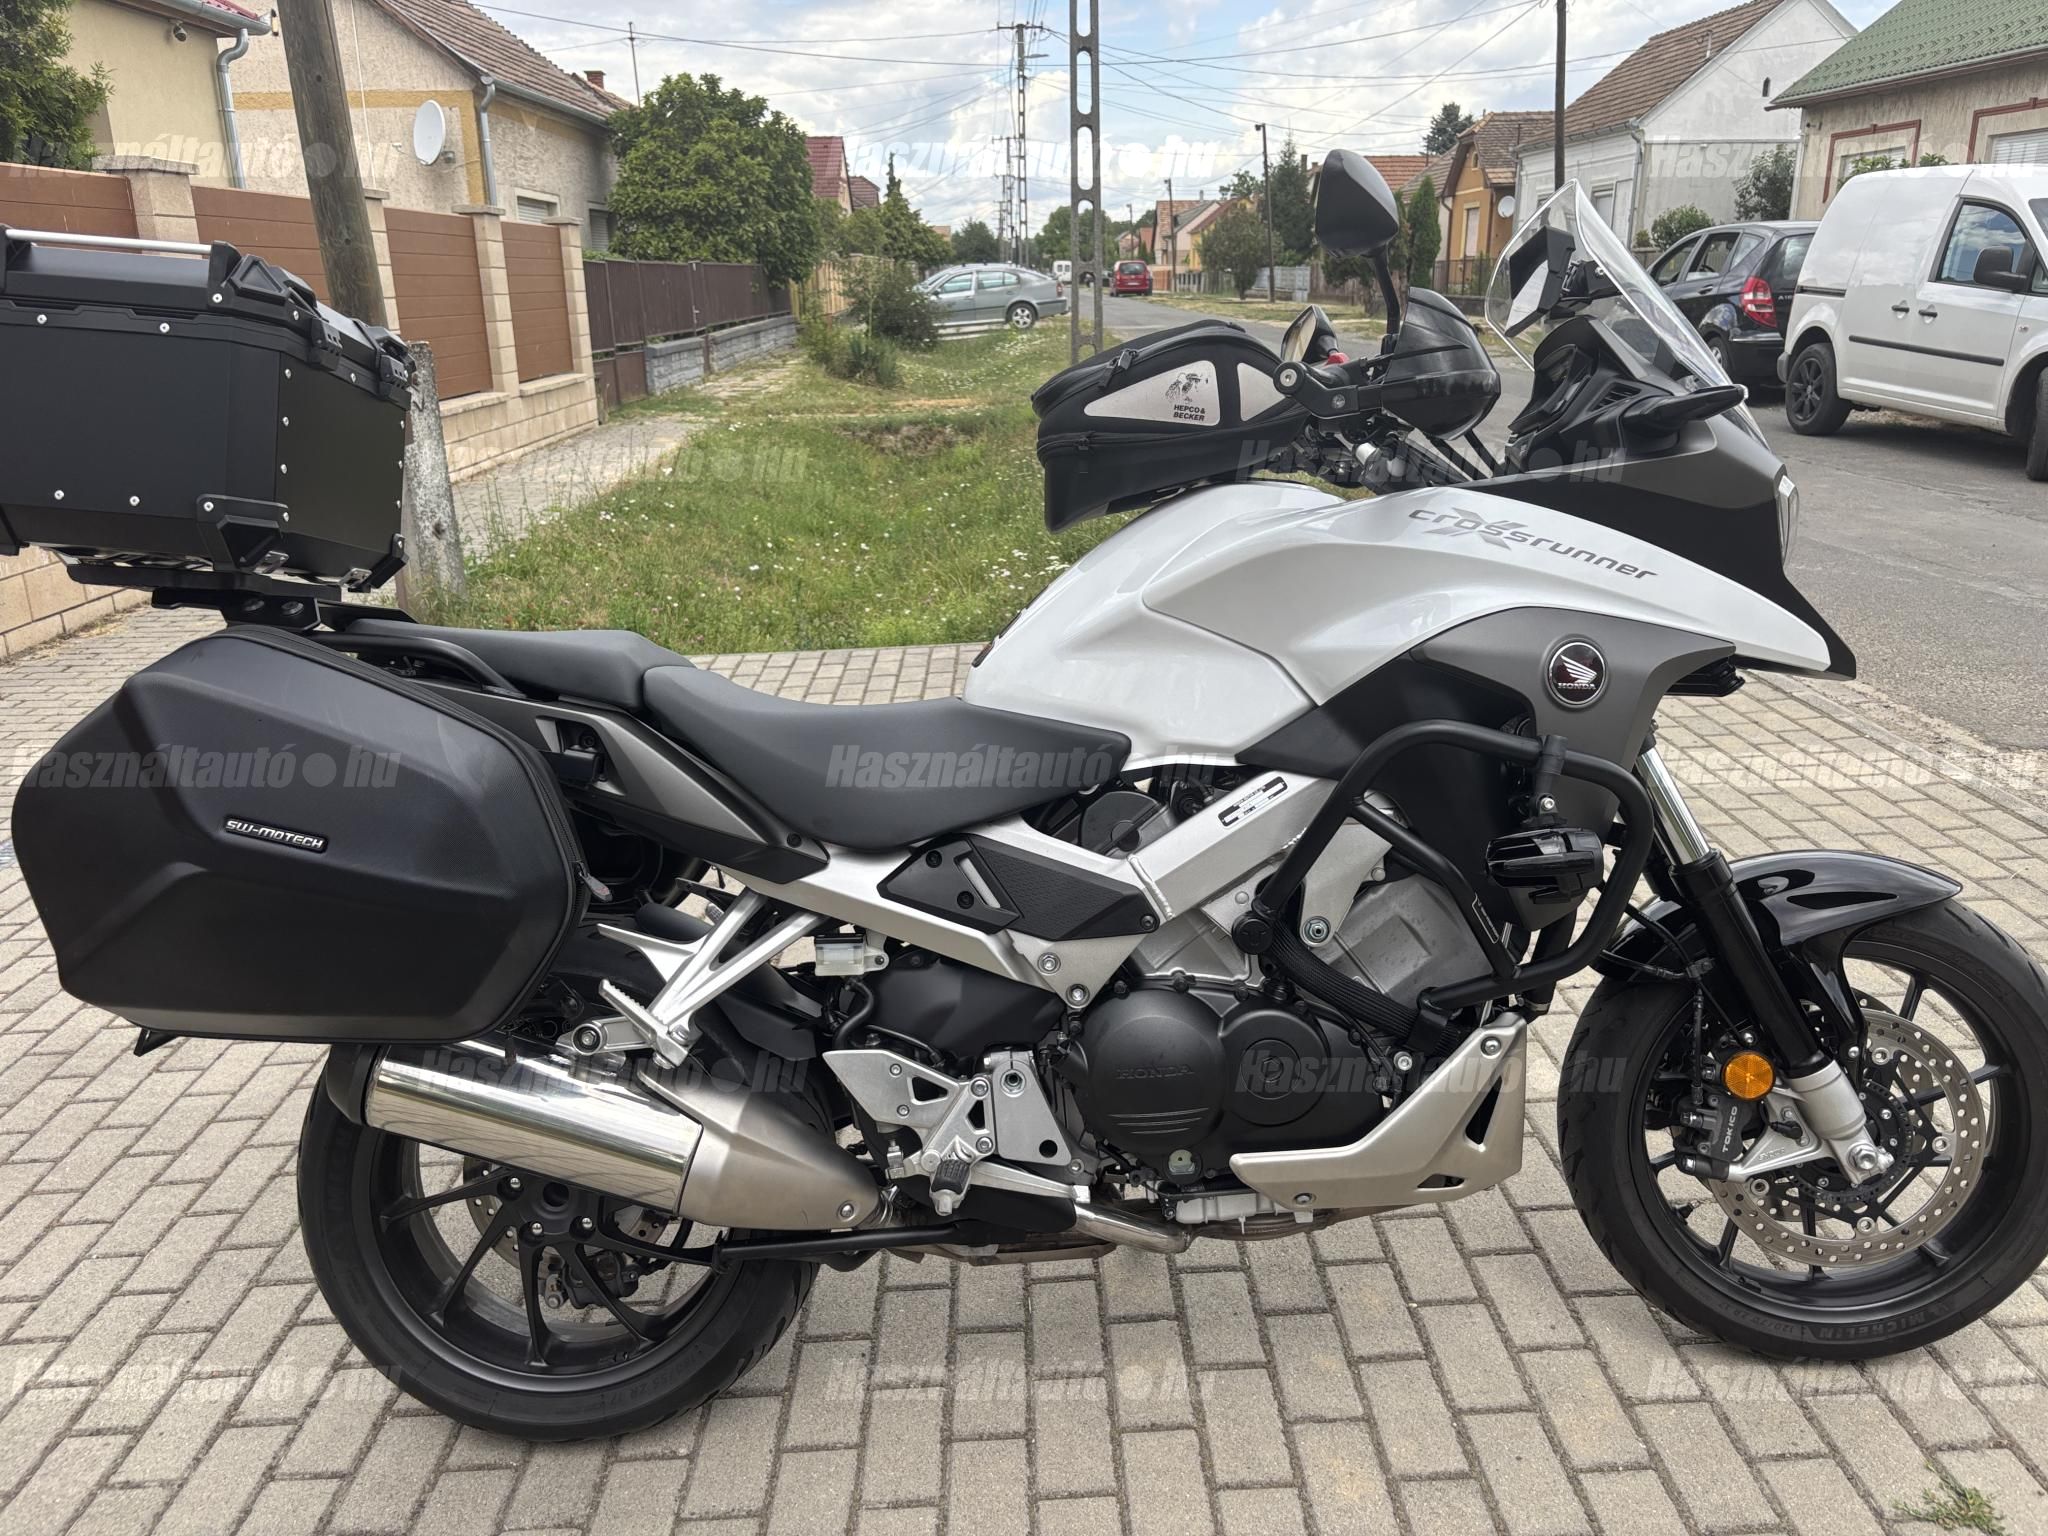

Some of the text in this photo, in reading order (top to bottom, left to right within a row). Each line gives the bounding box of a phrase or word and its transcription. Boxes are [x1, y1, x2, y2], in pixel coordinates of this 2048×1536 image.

[1173, 412, 1206, 421] BECKER
[1557, 682, 1597, 691] HONDA
[226, 820, 325, 849] SW-MOTECH
[1115, 1063, 1196, 1081] HONDA
[1721, 1105, 1739, 1153] TOKICO
[1818, 1310, 1928, 1341] MICHELIN
